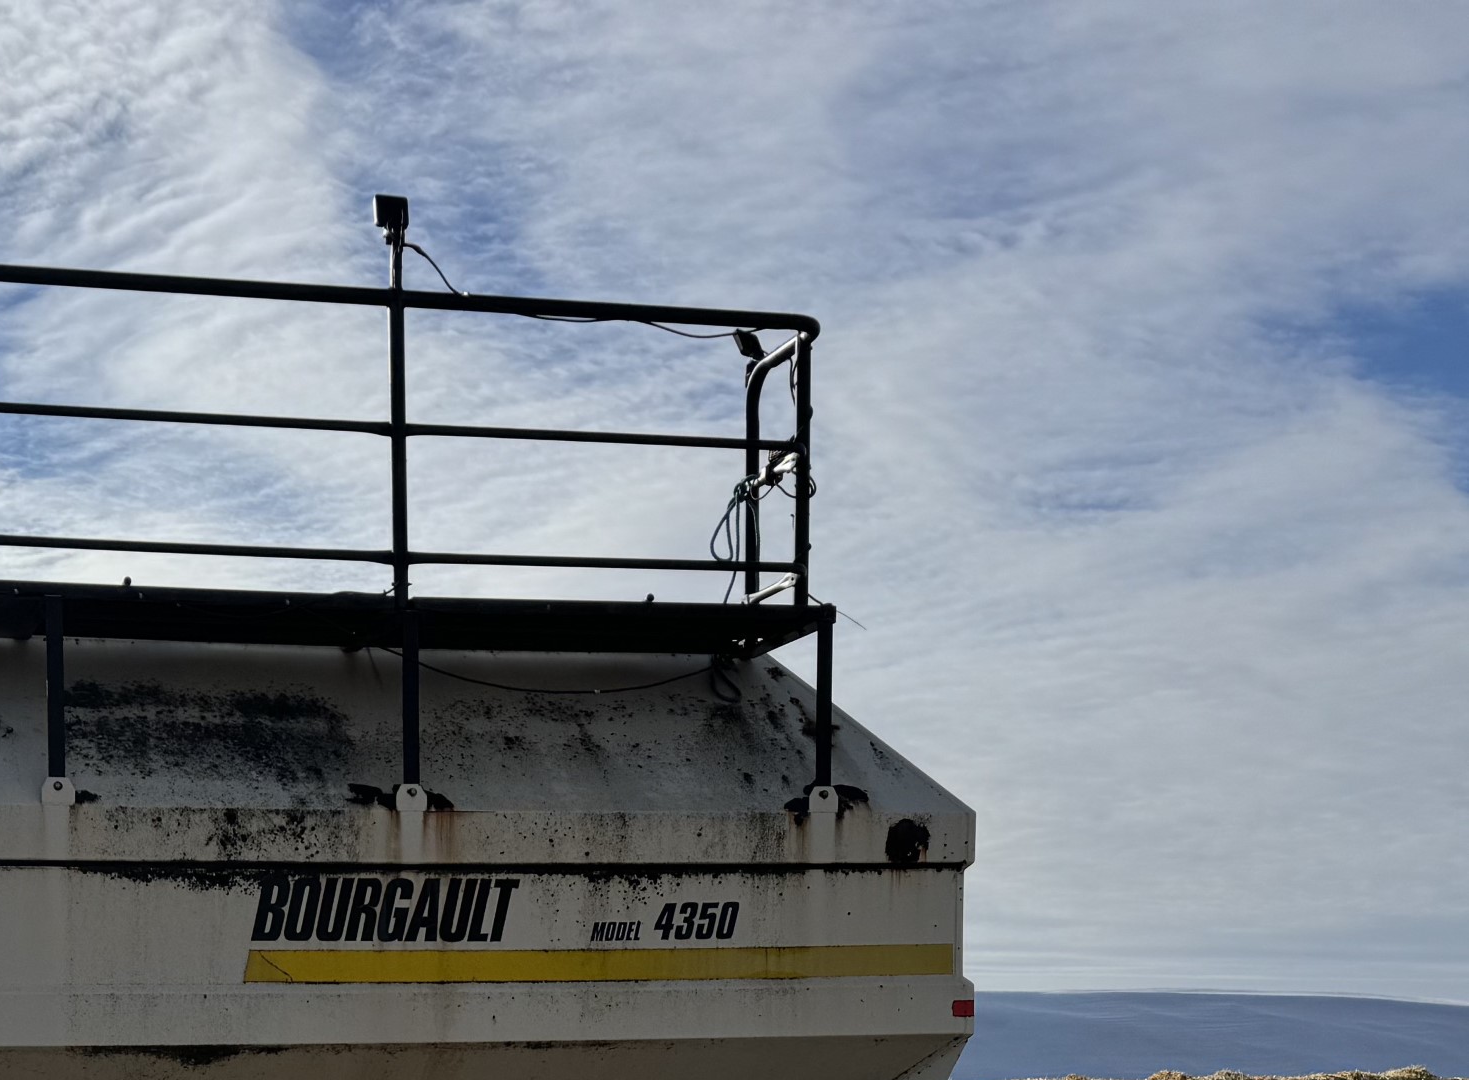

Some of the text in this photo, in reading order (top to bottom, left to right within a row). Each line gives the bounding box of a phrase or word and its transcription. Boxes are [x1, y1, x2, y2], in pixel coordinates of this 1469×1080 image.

[251, 877, 520, 942] BOURGAULT
[590, 901, 740, 941] MODEL 4350
